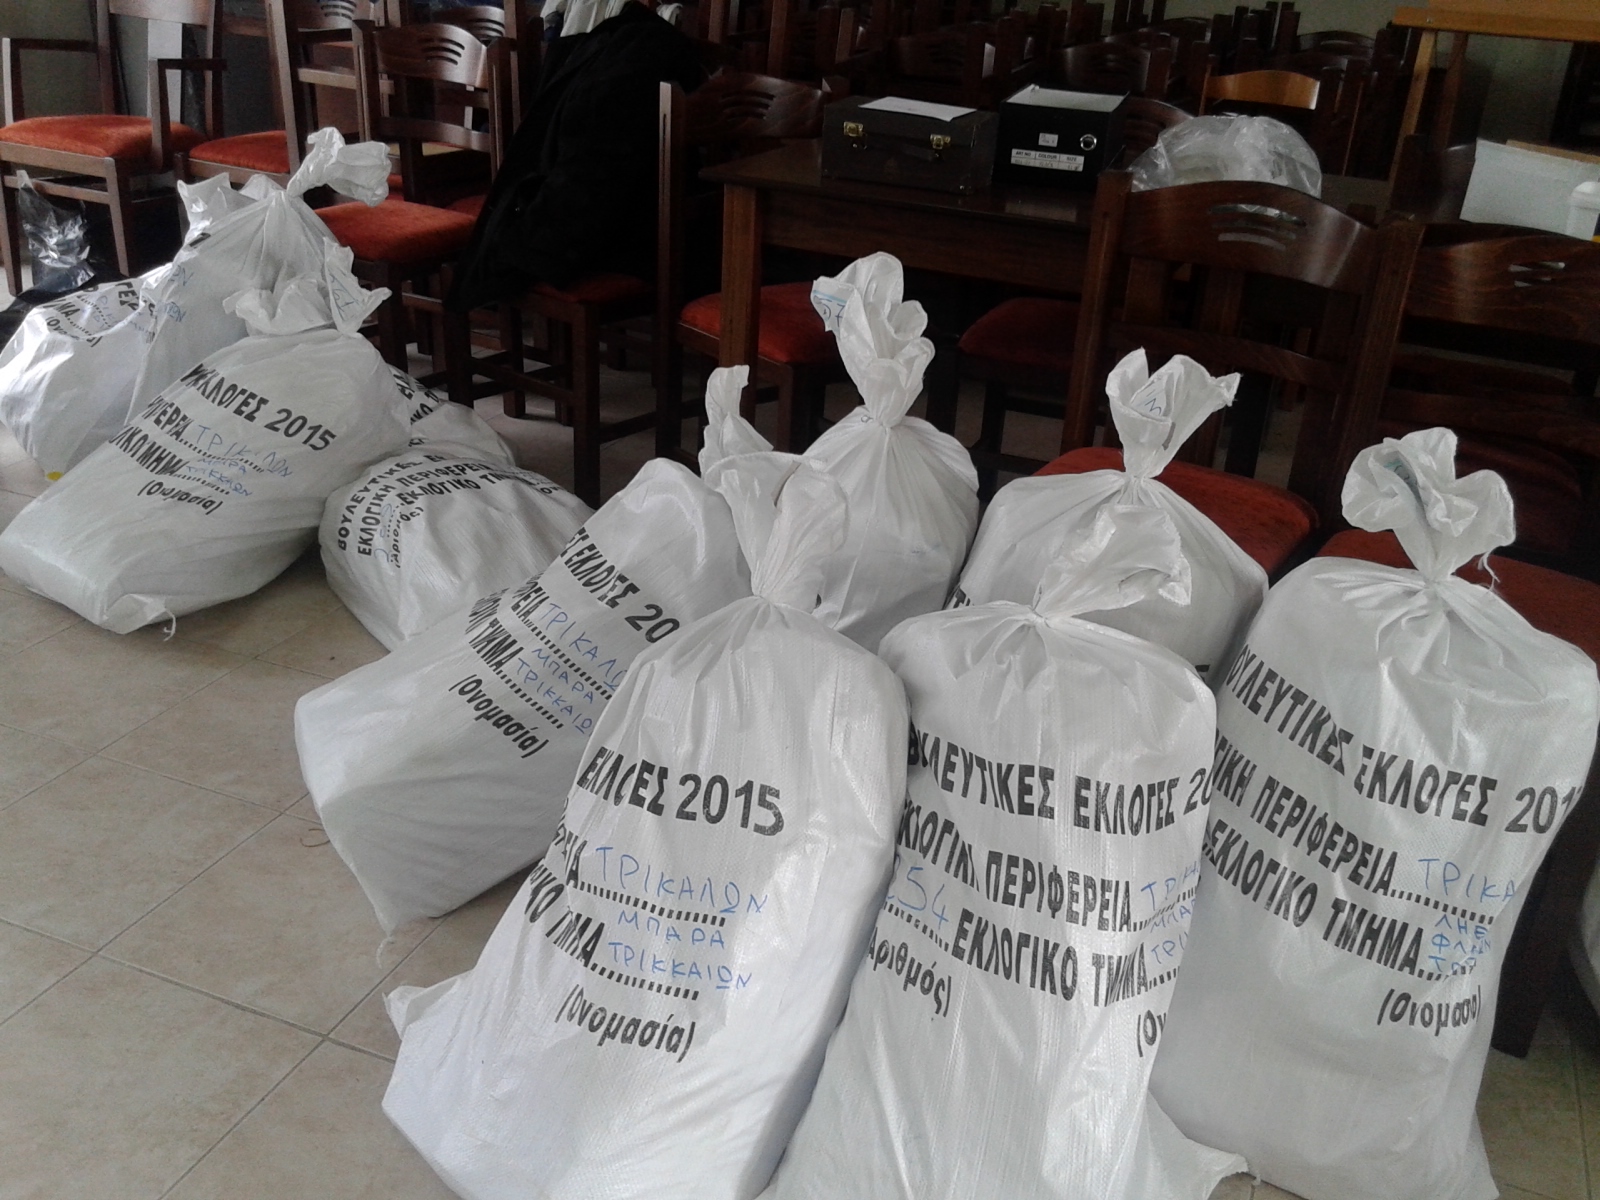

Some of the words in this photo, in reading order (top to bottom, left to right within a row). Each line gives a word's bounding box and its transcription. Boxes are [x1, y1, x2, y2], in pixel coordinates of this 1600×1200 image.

[264, 408, 338, 451] 2015
[357, 484, 397, 556] ΕΚΛΟΓΙΚΗ
[396, 478, 482, 505] ΕΚΛΟΓΙΚΟ
[532, 648, 594, 704] ΜΠΑΡΑ
[448, 674, 549, 759] (Ονομασία)
[676, 772, 785, 836] 2015
[1073, 775, 1180, 837] ΕΚΛΟΓΕΣ
[1353, 743, 1498, 828] ΕΚΛΟΓΕΣ
[1504, 785, 1583, 834] 201
[1250, 774, 1399, 897] ΠΕΡΙΦΕΡΕΙΑ
[595, 846, 768, 914] ΤΡΙΚΑΛΩΝ
[985, 849, 1132, 933] ΠΕΡΙΦΕΡΕΙΑ
[1211, 818, 1319, 928] ΕΚΛΟΓΙΚΟ
[1322, 896, 1425, 977] ΤΜΗΜΑ
[617, 909, 726, 949] ΜΠΑΡΑ
[951, 907, 1079, 1002] ΕΚΛΟΓΙΚΟ
[607, 941, 752, 989] ΤΡΙΚΚΑΙΩΝ
[554, 983, 697, 1063] (Ονομασία)
